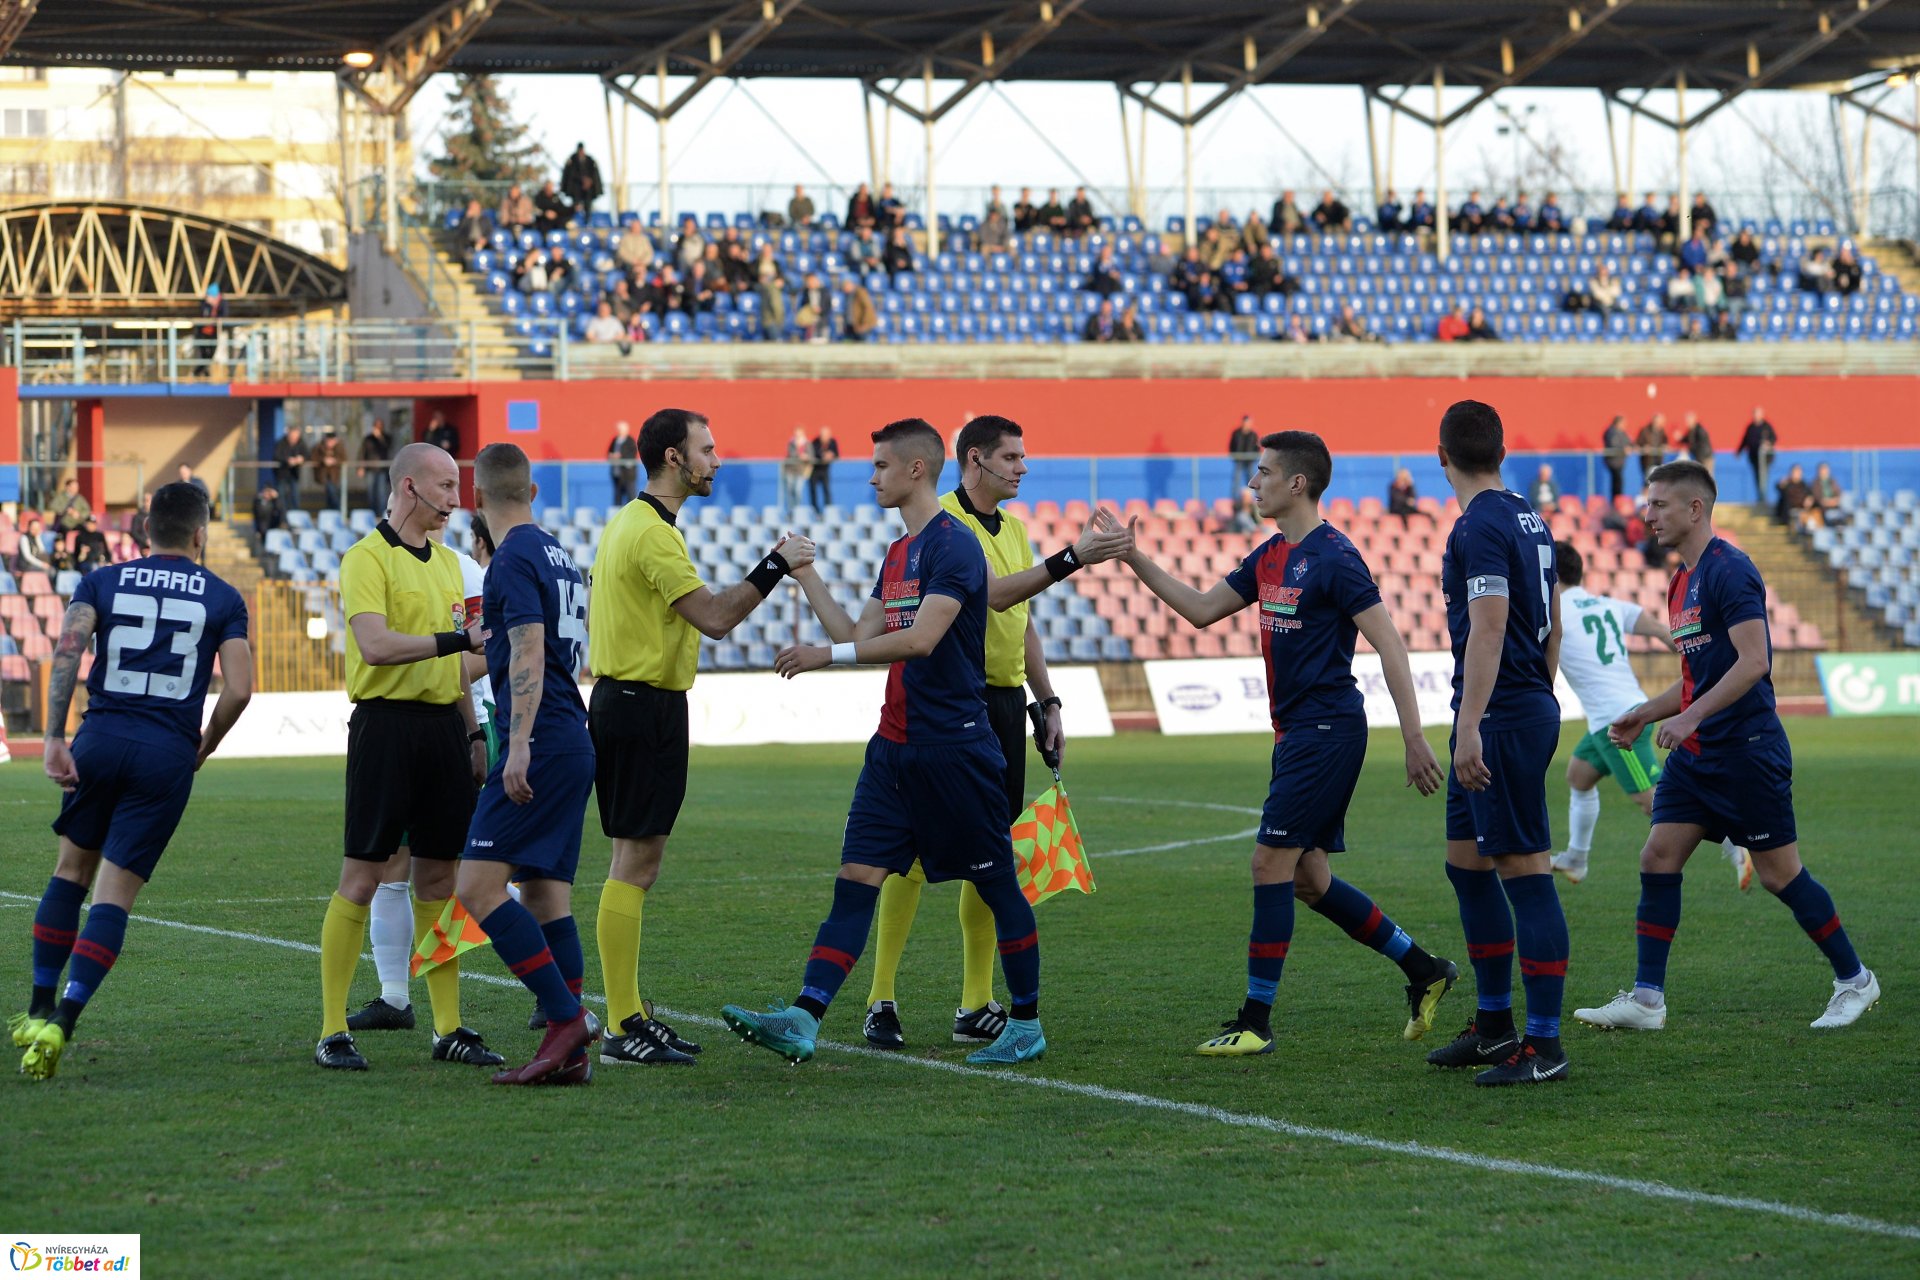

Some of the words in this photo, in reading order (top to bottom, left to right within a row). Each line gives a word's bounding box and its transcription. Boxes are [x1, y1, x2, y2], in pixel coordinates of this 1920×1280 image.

[119, 567, 206, 595] FORRÓ
[1473, 575, 1487, 594] C
[104, 593, 207, 700] 23
[1582, 609, 1626, 666] 21
[978, 861, 993, 870] JAKO
